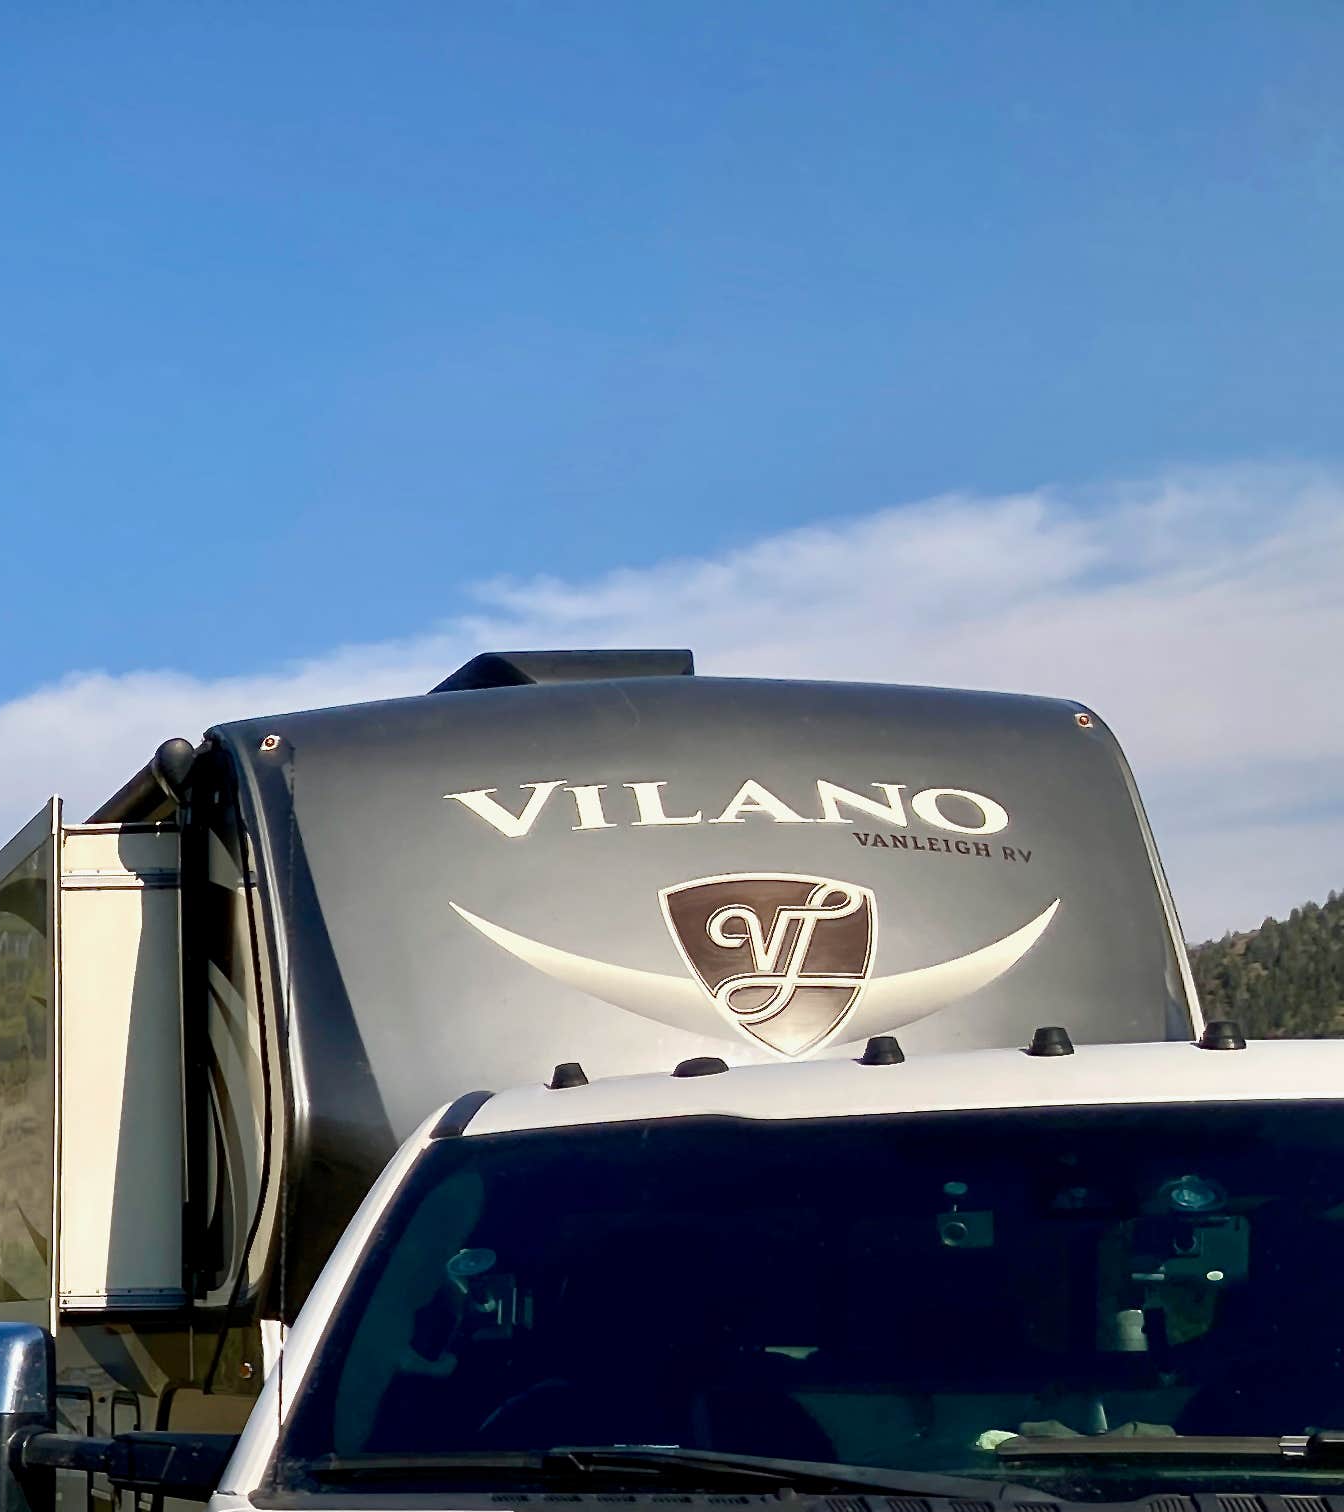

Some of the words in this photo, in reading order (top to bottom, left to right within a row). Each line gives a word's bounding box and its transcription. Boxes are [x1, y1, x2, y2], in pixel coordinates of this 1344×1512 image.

[442, 779, 1010, 838] VILANO
[852, 832, 992, 858] VANLEIGH
[1002, 846, 1033, 864] RV
